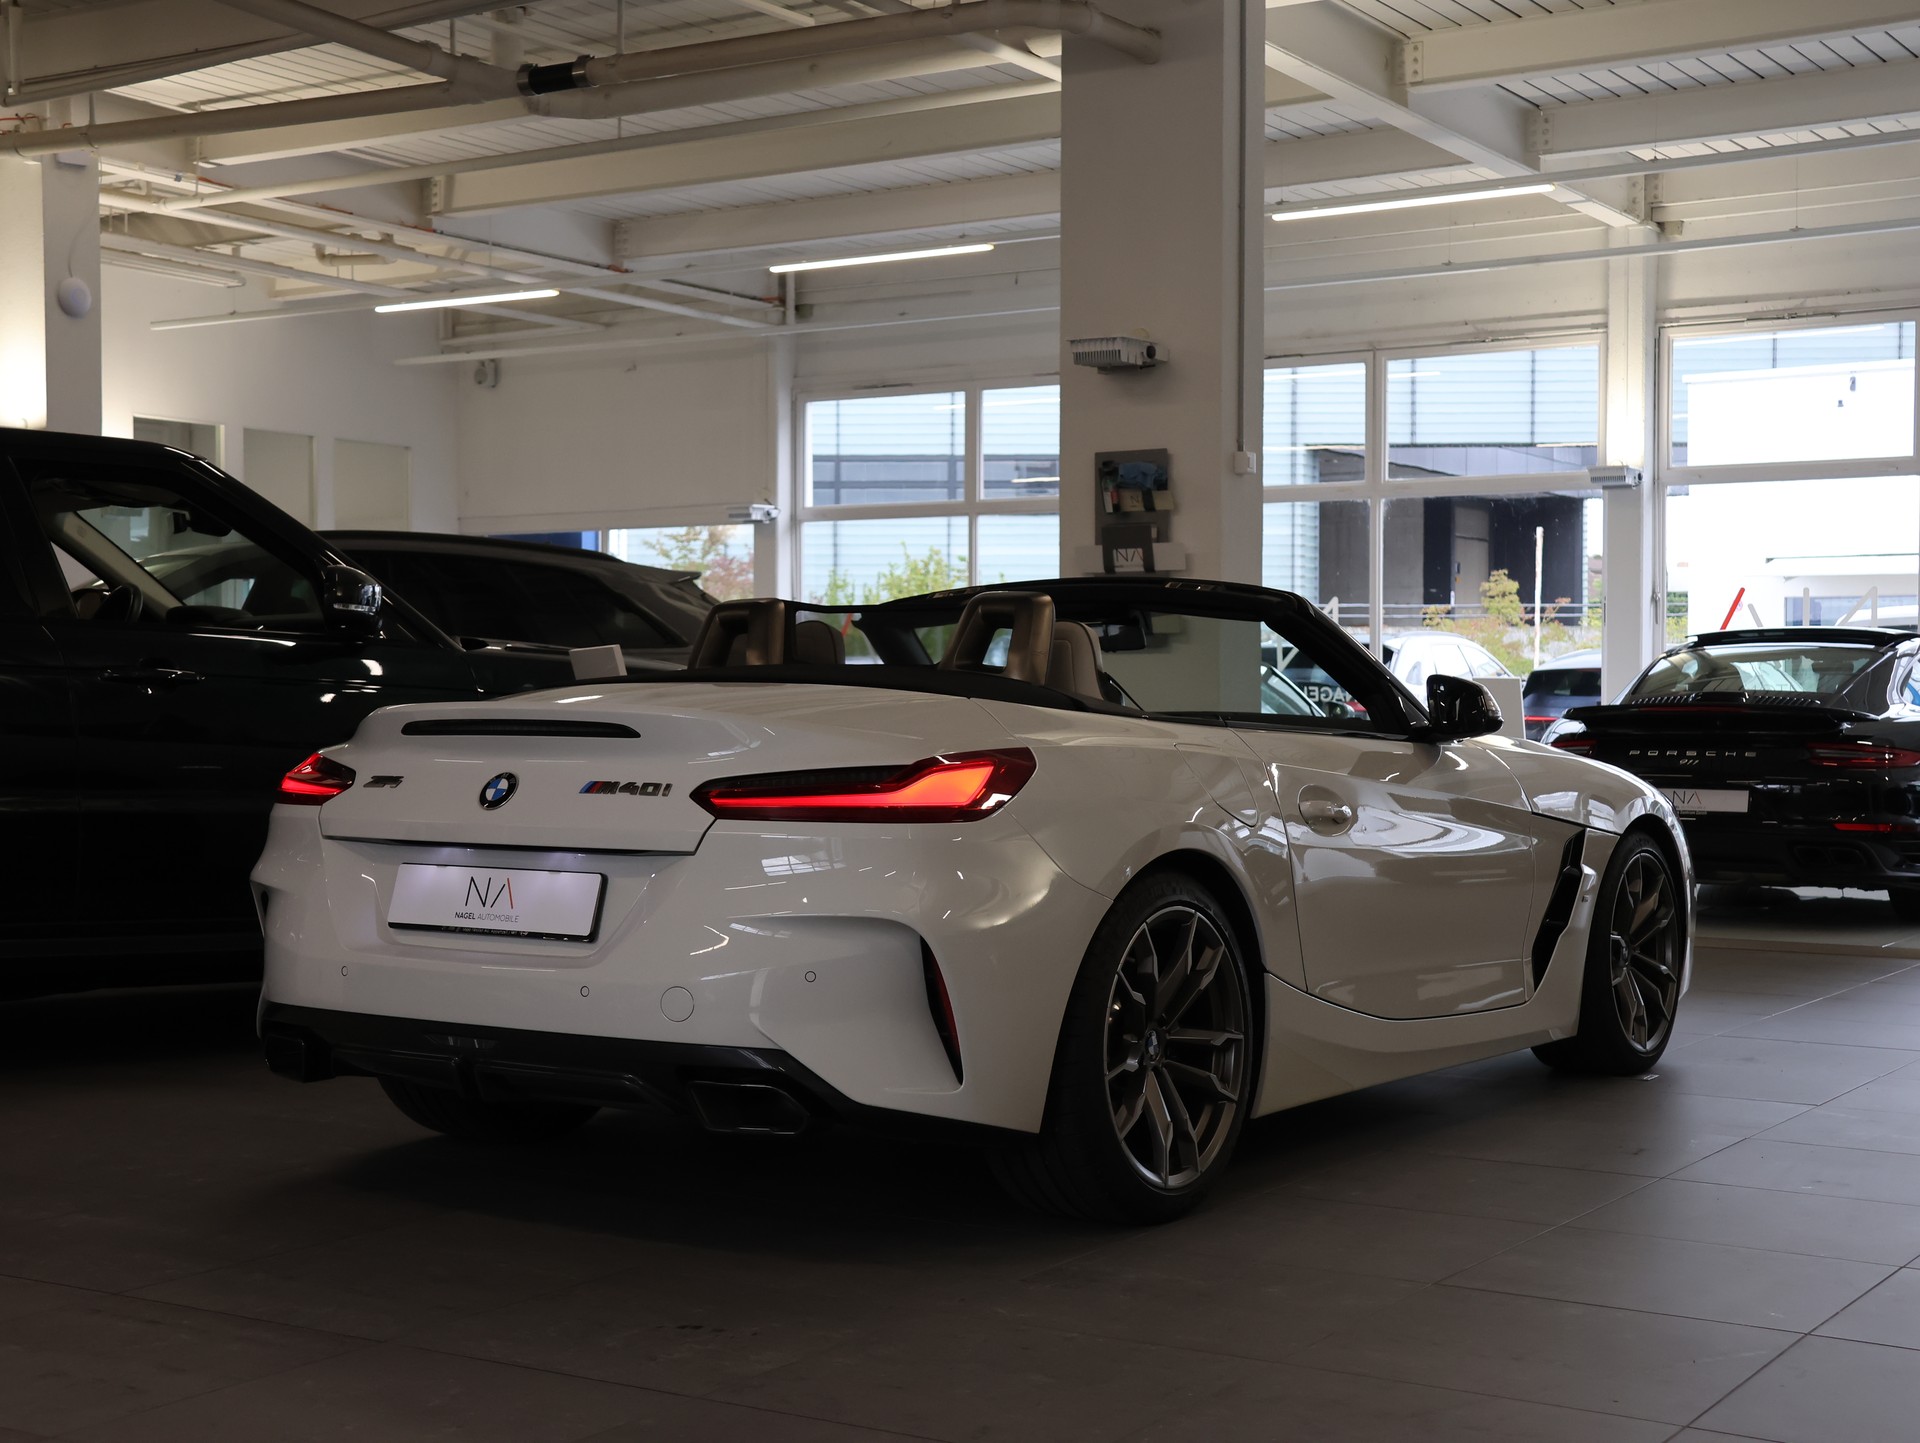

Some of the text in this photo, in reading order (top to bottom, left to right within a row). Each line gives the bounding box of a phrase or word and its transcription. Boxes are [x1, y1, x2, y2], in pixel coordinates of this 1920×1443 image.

[1629, 749, 1757, 758] PORSCHE
[454, 911, 520, 923] NAGEL AUTOMOBILE
